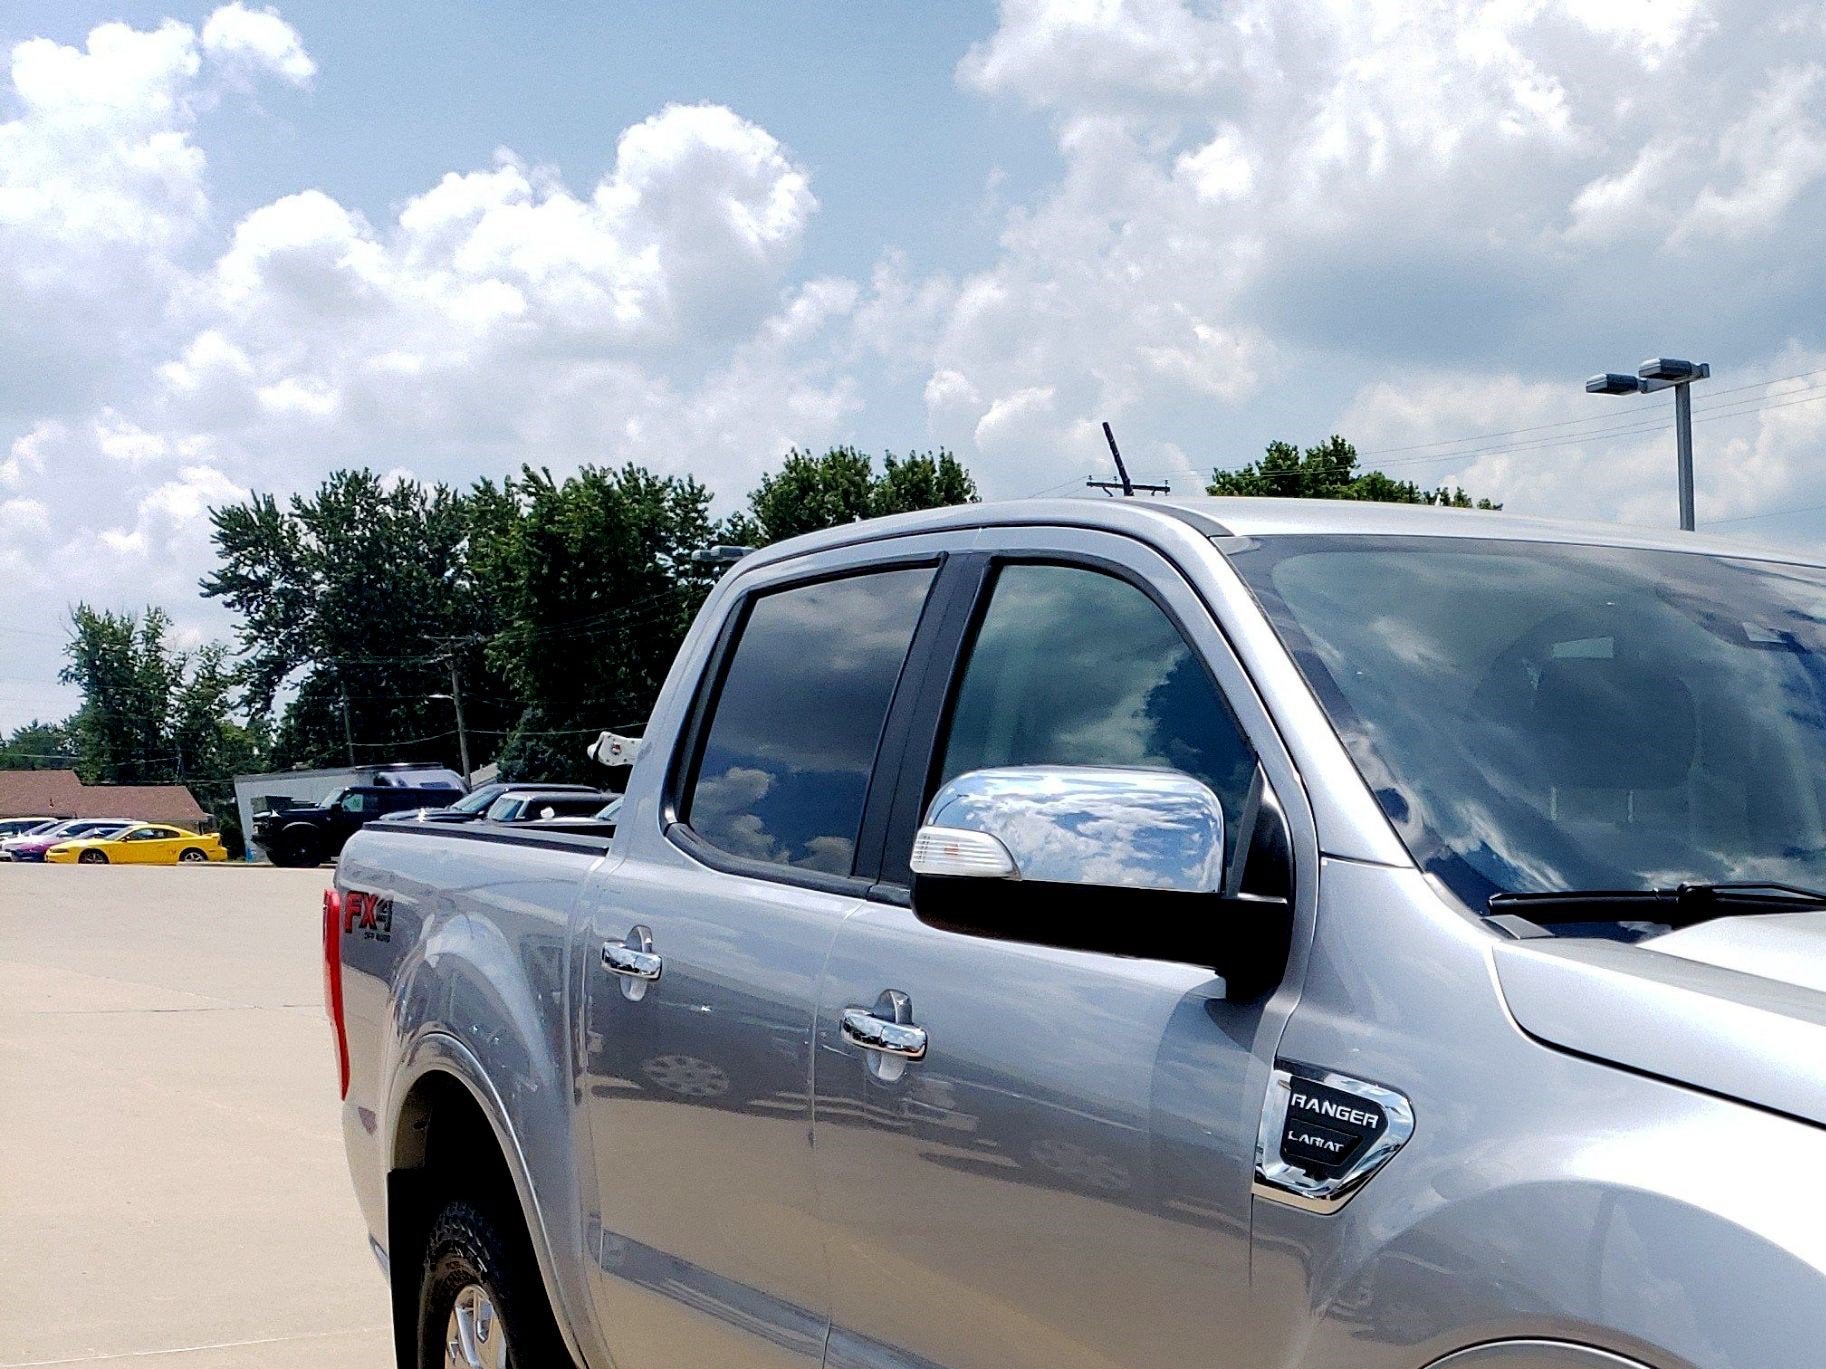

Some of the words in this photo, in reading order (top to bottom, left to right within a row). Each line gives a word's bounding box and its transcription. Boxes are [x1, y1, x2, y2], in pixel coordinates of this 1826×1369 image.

[345, 890, 393, 934] FX4
[1291, 1093, 1378, 1129] RANGER
[1288, 1130, 1344, 1153] LARIAT
